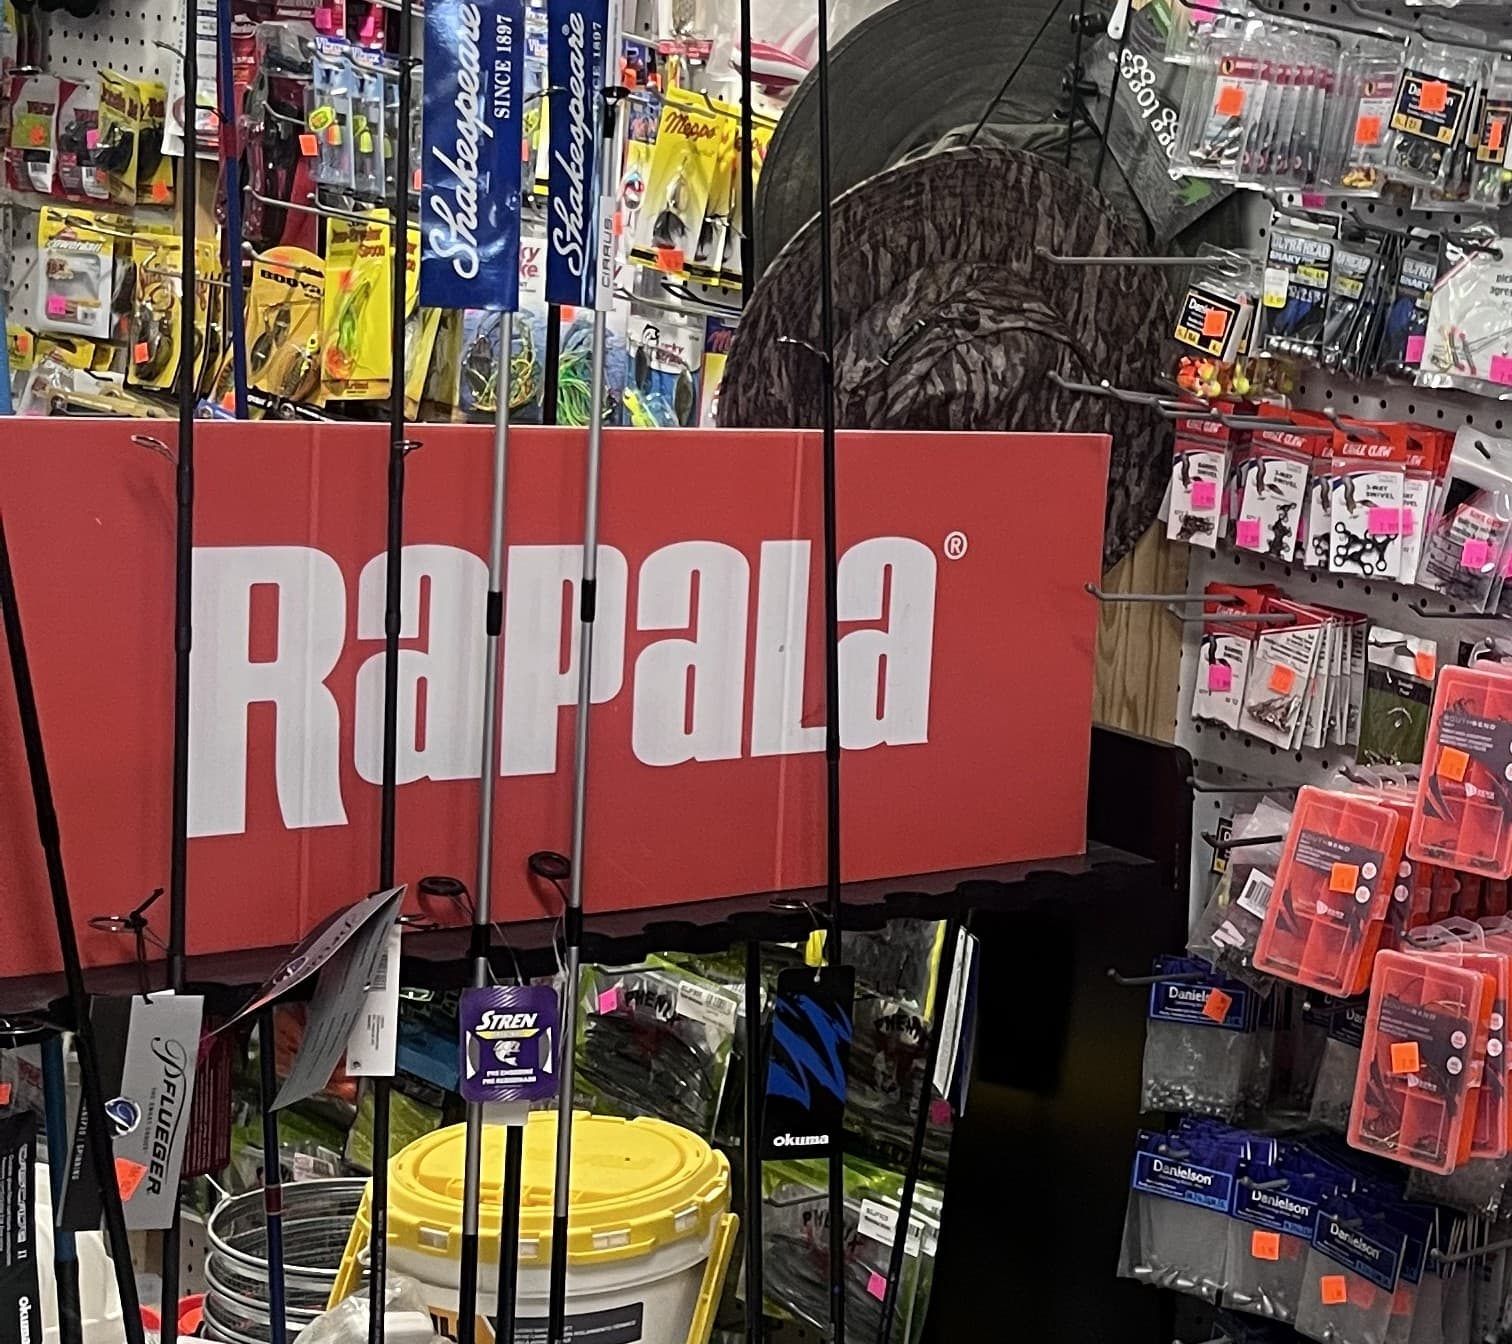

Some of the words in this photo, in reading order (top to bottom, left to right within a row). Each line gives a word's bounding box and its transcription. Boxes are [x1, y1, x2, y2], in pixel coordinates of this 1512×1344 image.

[494, 14, 511, 65] 1897
[494, 70, 511, 120] SINCE
[428, 3, 481, 281] Shakespeare
[552, 10, 599, 278] Shakespeare
[664, 110, 716, 142] Mepps
[601, 217, 612, 289] CIRRUS
[185, 535, 938, 839] Rapala
[478, 1011, 539, 1031] STREN
[150, 1034, 187, 1198] PFLUEGER
[772, 1132, 830, 1148] okuma
[1152, 1159, 1213, 1187] Danielson
